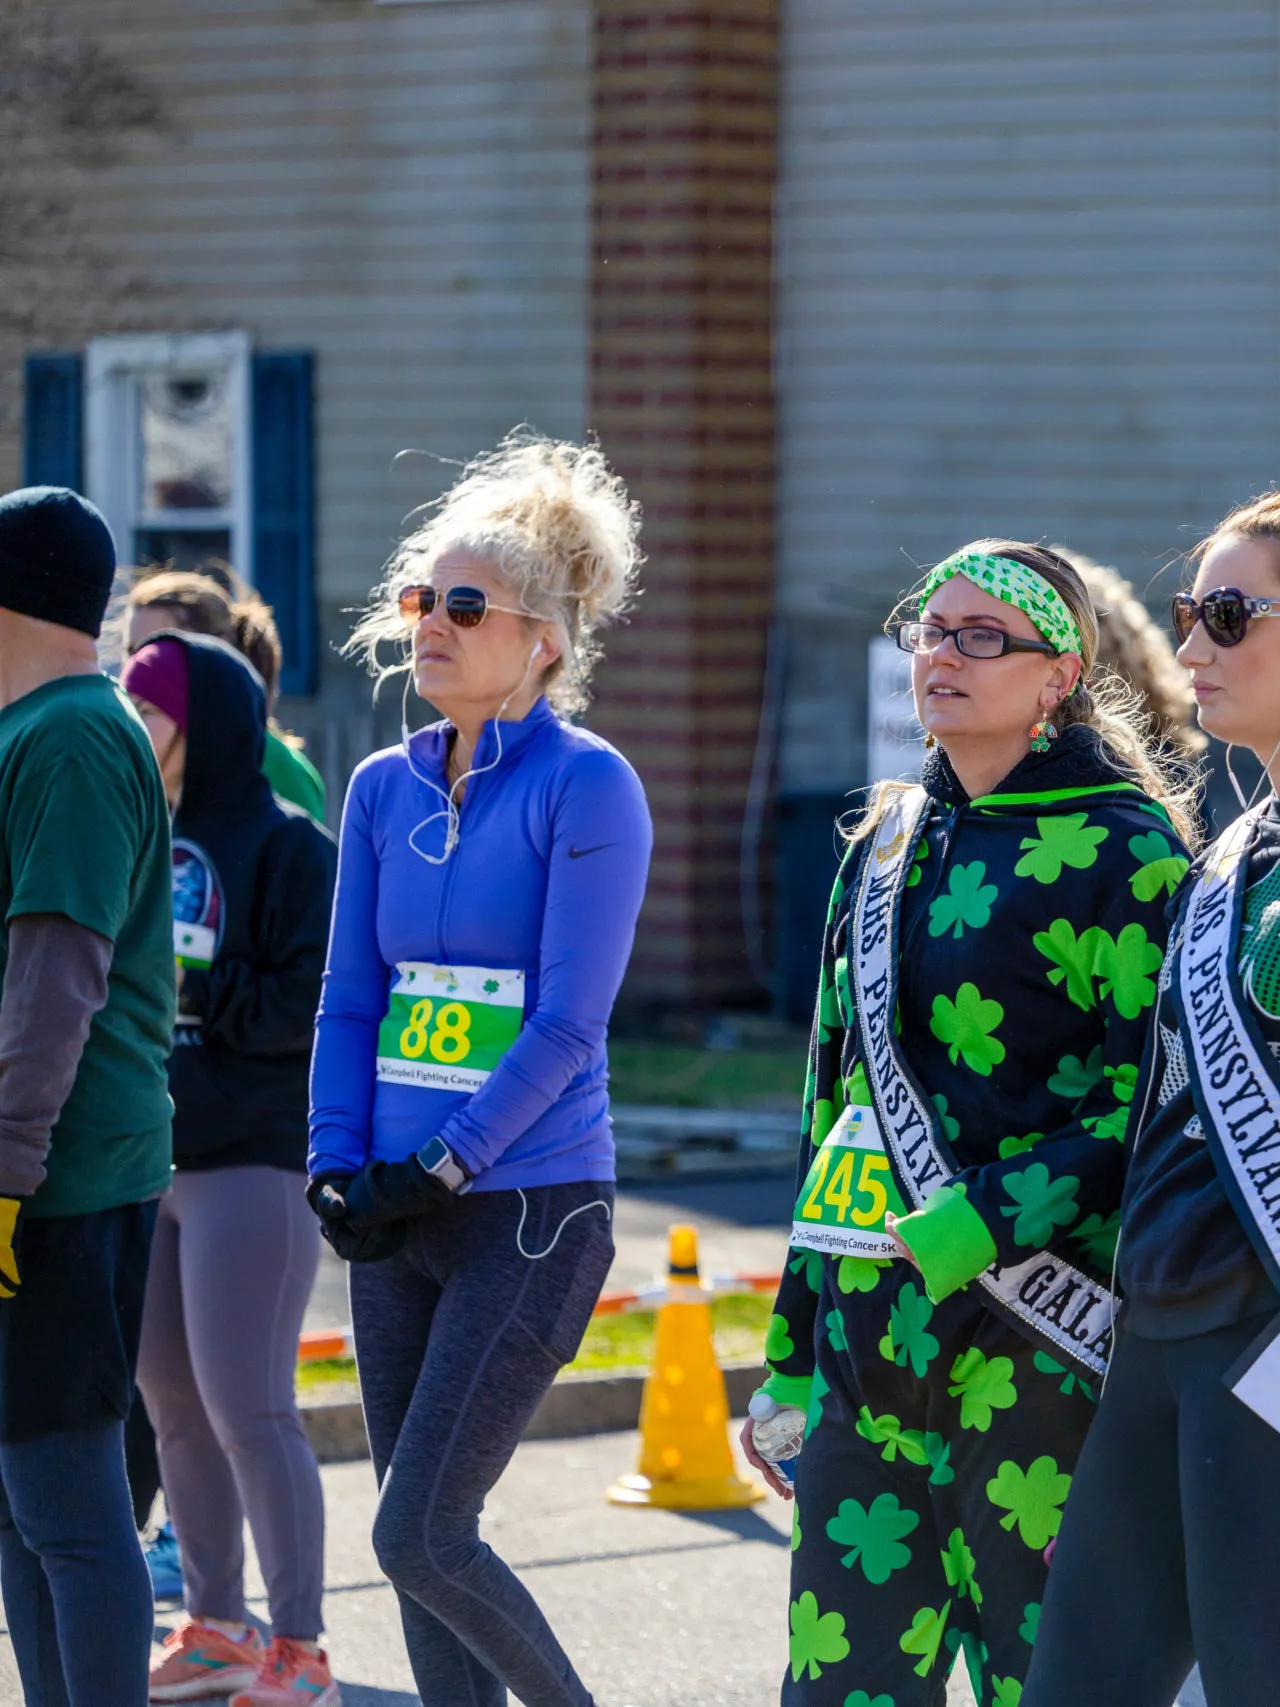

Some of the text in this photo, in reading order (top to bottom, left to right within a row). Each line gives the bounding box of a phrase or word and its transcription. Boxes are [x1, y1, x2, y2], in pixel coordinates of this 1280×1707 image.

[860, 861, 901, 969] MRS.
[399, 998, 472, 1064] 88
[416, 1070, 449, 1084] Fighting
[802, 1149, 891, 1227] 245
[825, 1234, 848, 1249] Fighting
[848, 1238, 879, 1252] Cancer
[881, 1243, 897, 1253] 5K
[1018, 1264, 1118, 1363] GALA
